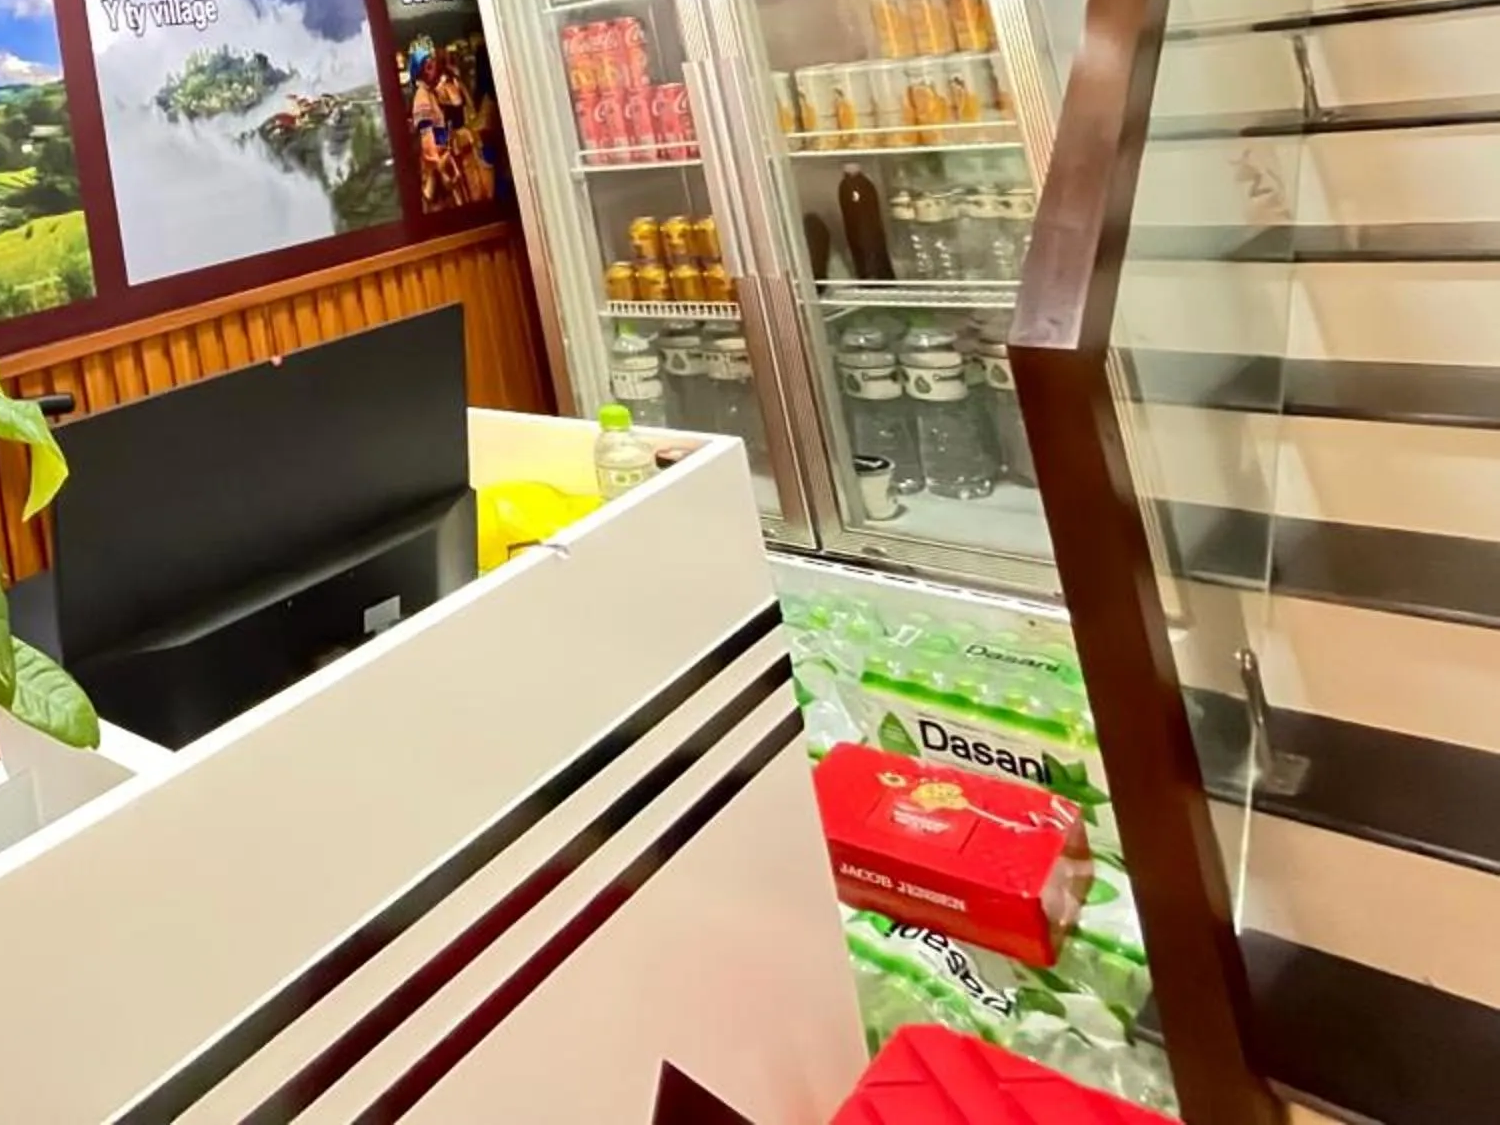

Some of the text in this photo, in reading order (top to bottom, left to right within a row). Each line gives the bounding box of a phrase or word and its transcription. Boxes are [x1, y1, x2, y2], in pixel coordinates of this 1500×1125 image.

[965, 643, 1062, 674] Dasani
[918, 718, 1053, 786] Dasani
[838, 862, 895, 889] JACOB
